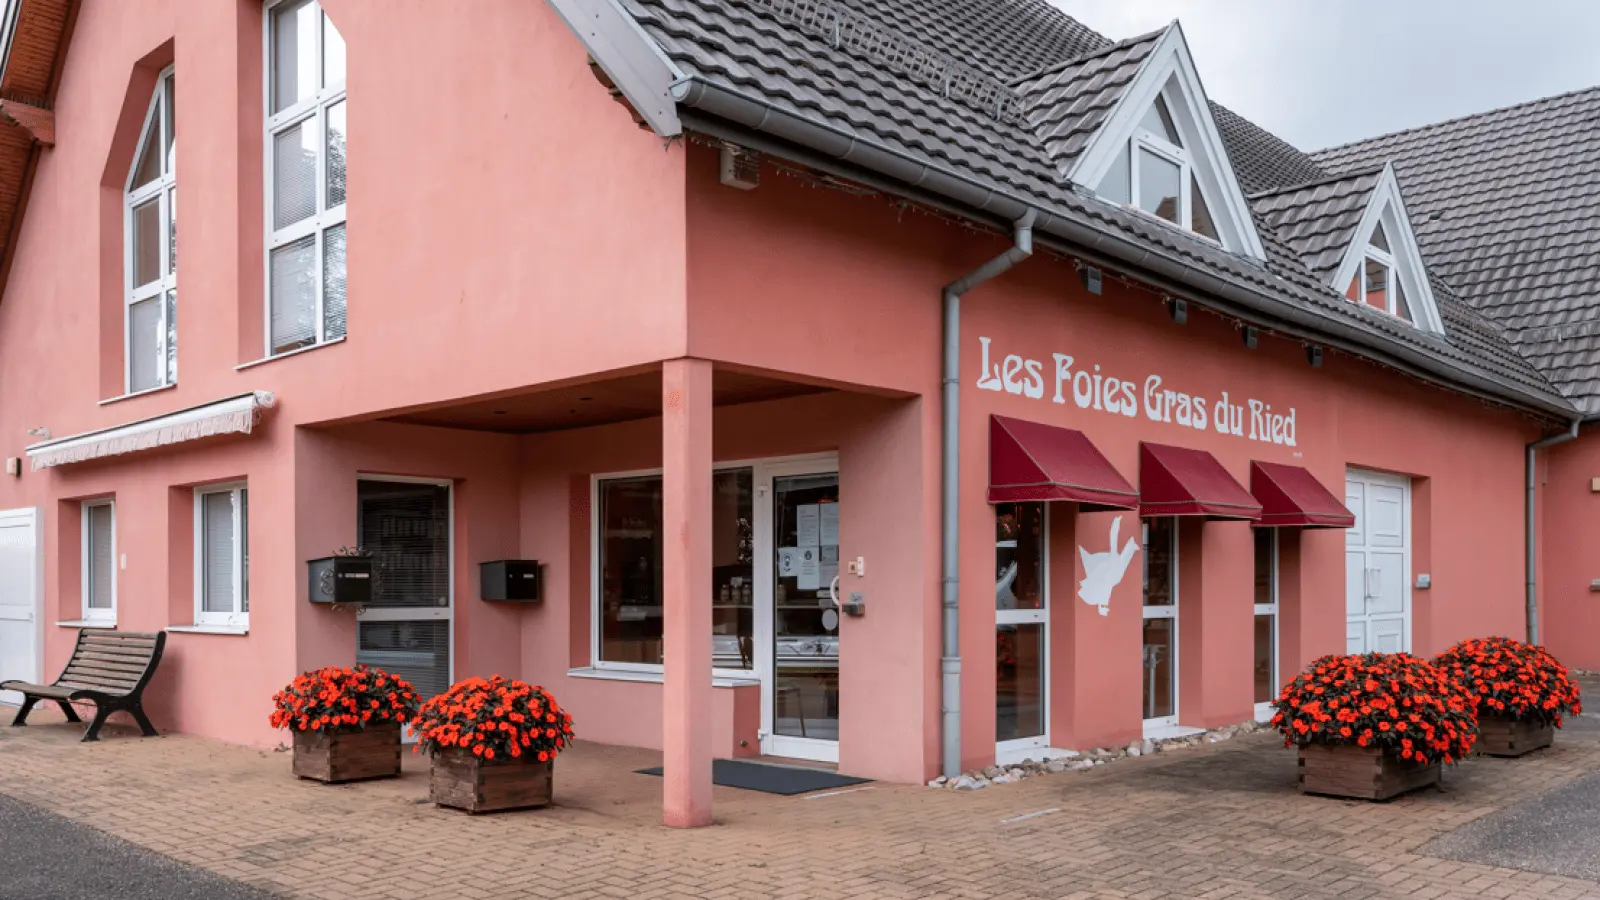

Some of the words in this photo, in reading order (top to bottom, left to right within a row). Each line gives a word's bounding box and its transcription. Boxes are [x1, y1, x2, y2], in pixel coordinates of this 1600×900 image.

[976, 336, 1044, 399] Les
[1052, 352, 1137, 418] Foies
[1143, 374, 1208, 430] Gras
[1213, 391, 1244, 437] du
[1247, 398, 1297, 447] Ried
